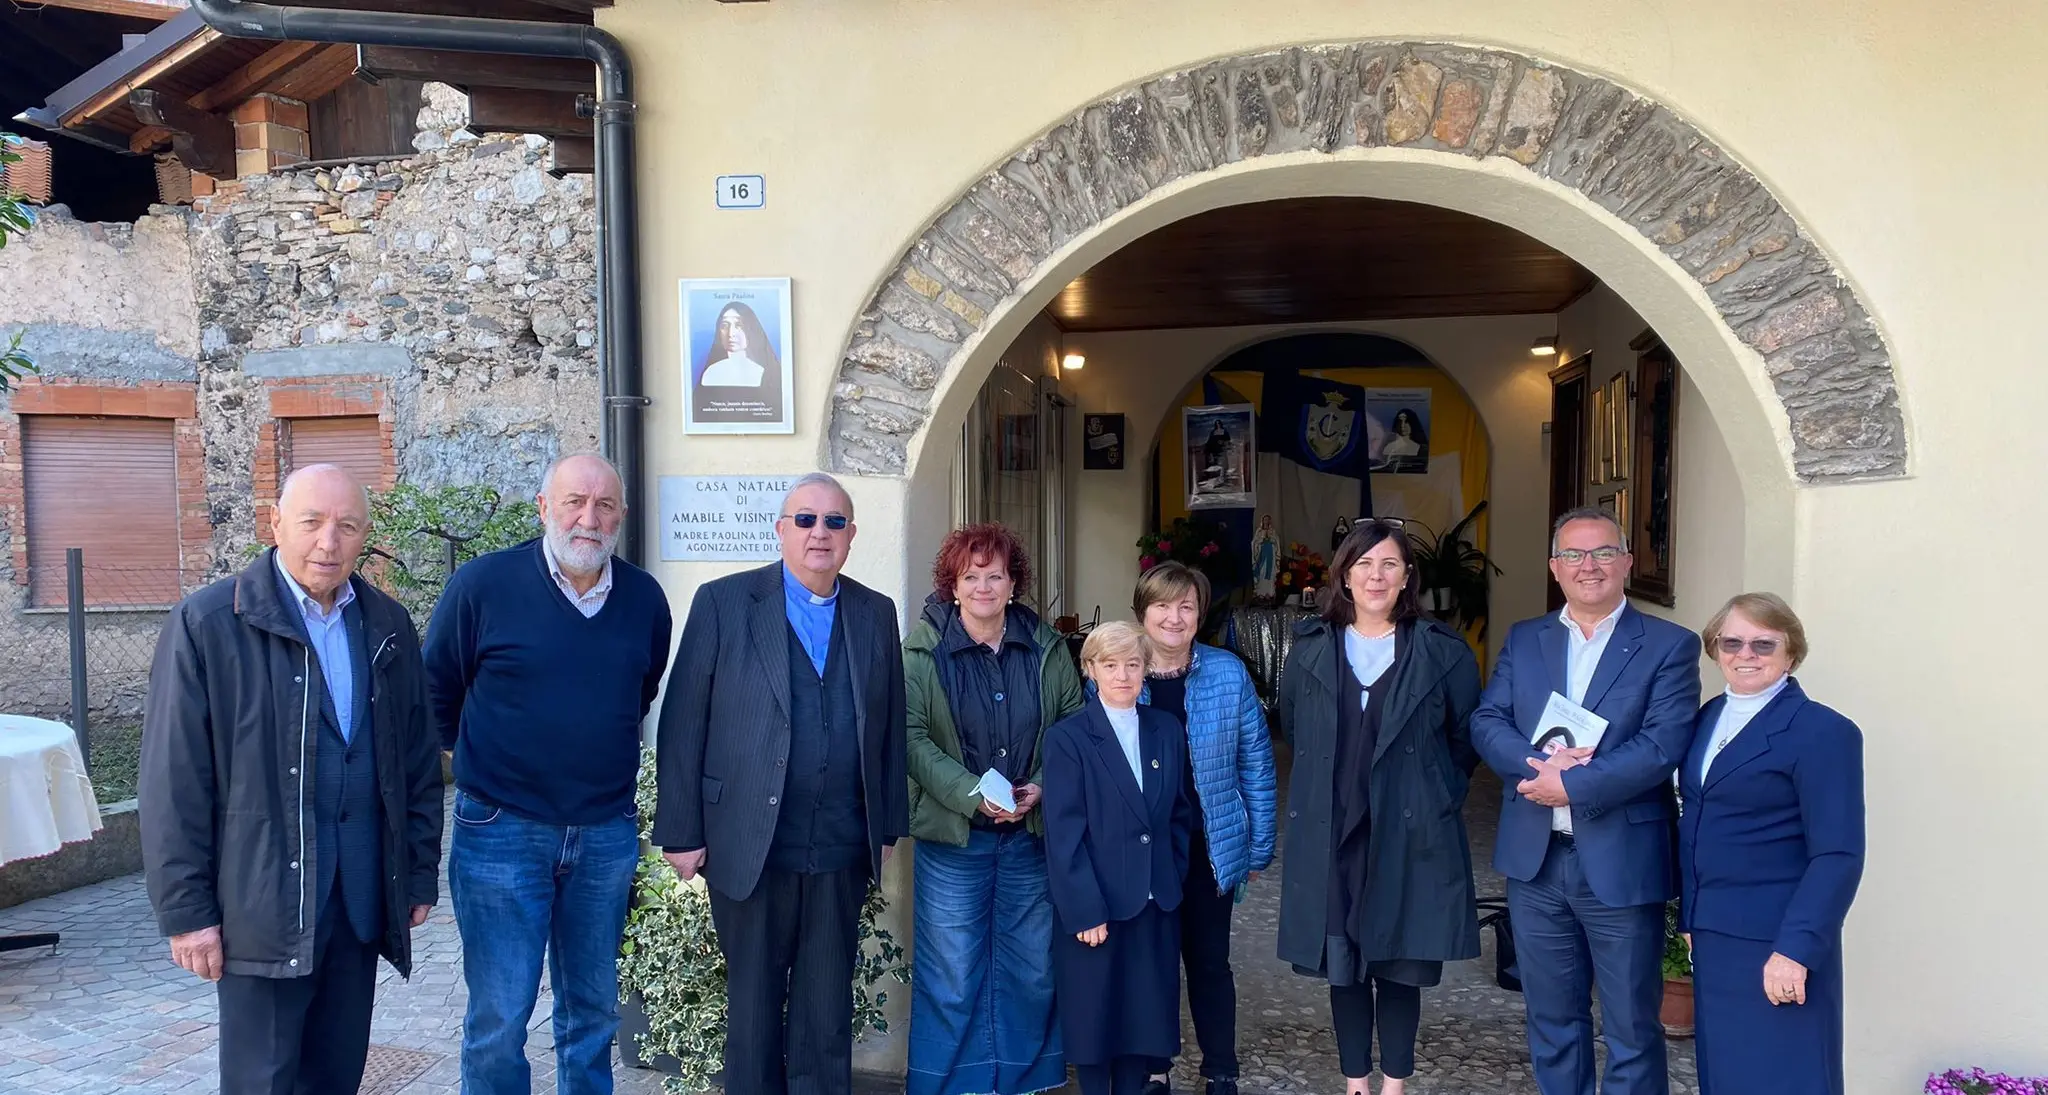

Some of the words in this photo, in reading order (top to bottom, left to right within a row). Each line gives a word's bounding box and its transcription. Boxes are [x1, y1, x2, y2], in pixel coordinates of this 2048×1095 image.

[730, 183, 749, 199] 16
[696, 481, 728, 492] CASA
[738, 481, 788, 492] NATALE
[736, 496, 747, 504] DI
[672, 512, 725, 523] AMABILE
[673, 531, 709, 540] MADRE
[712, 531, 756, 540] PAOLINA
[759, 531, 777, 540] DEL
[686, 543, 760, 552] AGONIZZANTE
[764, 544, 772, 552] DI
